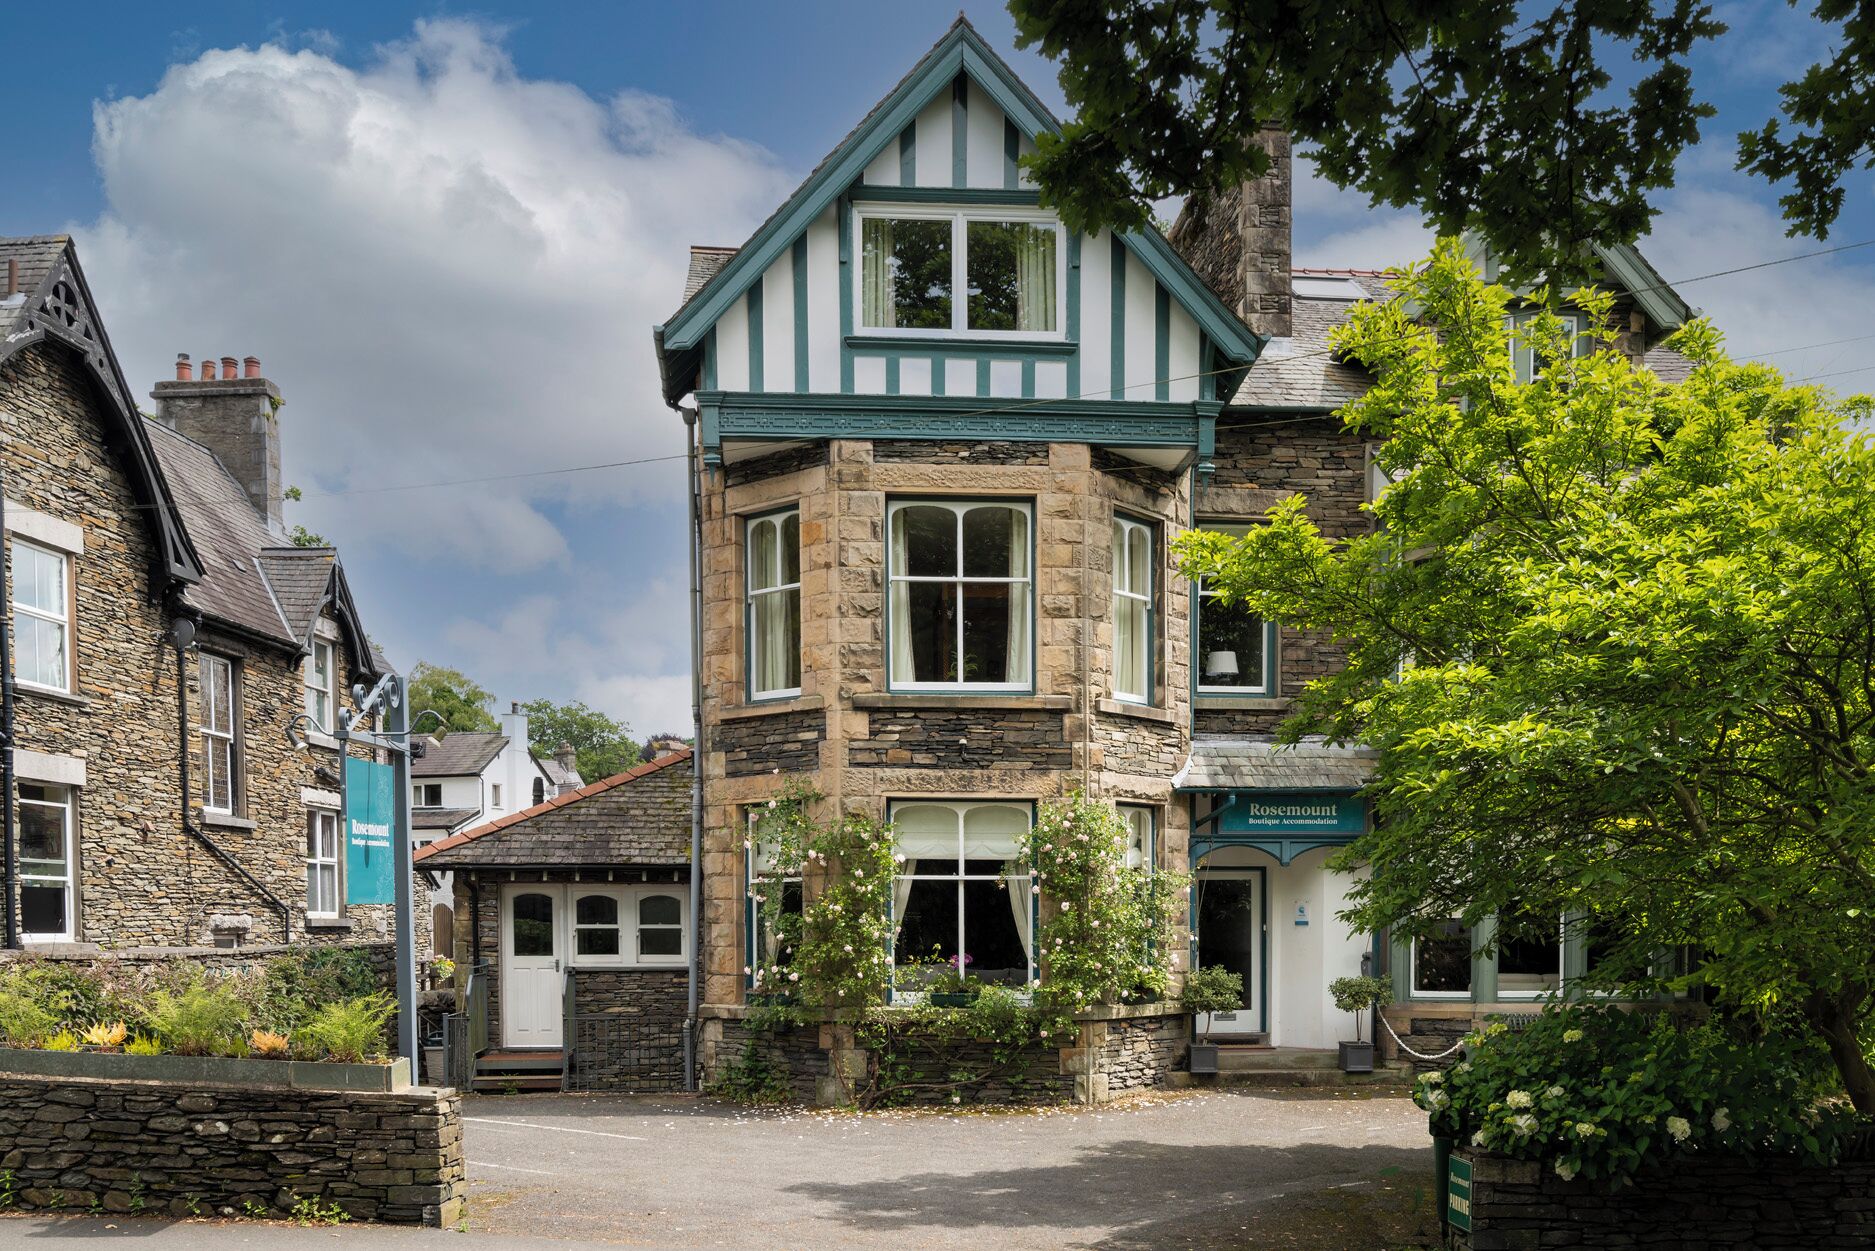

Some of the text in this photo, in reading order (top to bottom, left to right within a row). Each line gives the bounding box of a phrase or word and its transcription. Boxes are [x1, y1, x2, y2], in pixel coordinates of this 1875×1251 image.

[1250, 803, 1337, 816] Rosemount
[351, 819, 389, 837] Rosemount
[1249, 818, 1280, 826] Boutique
[1450, 1193, 1469, 1216] PARKING
